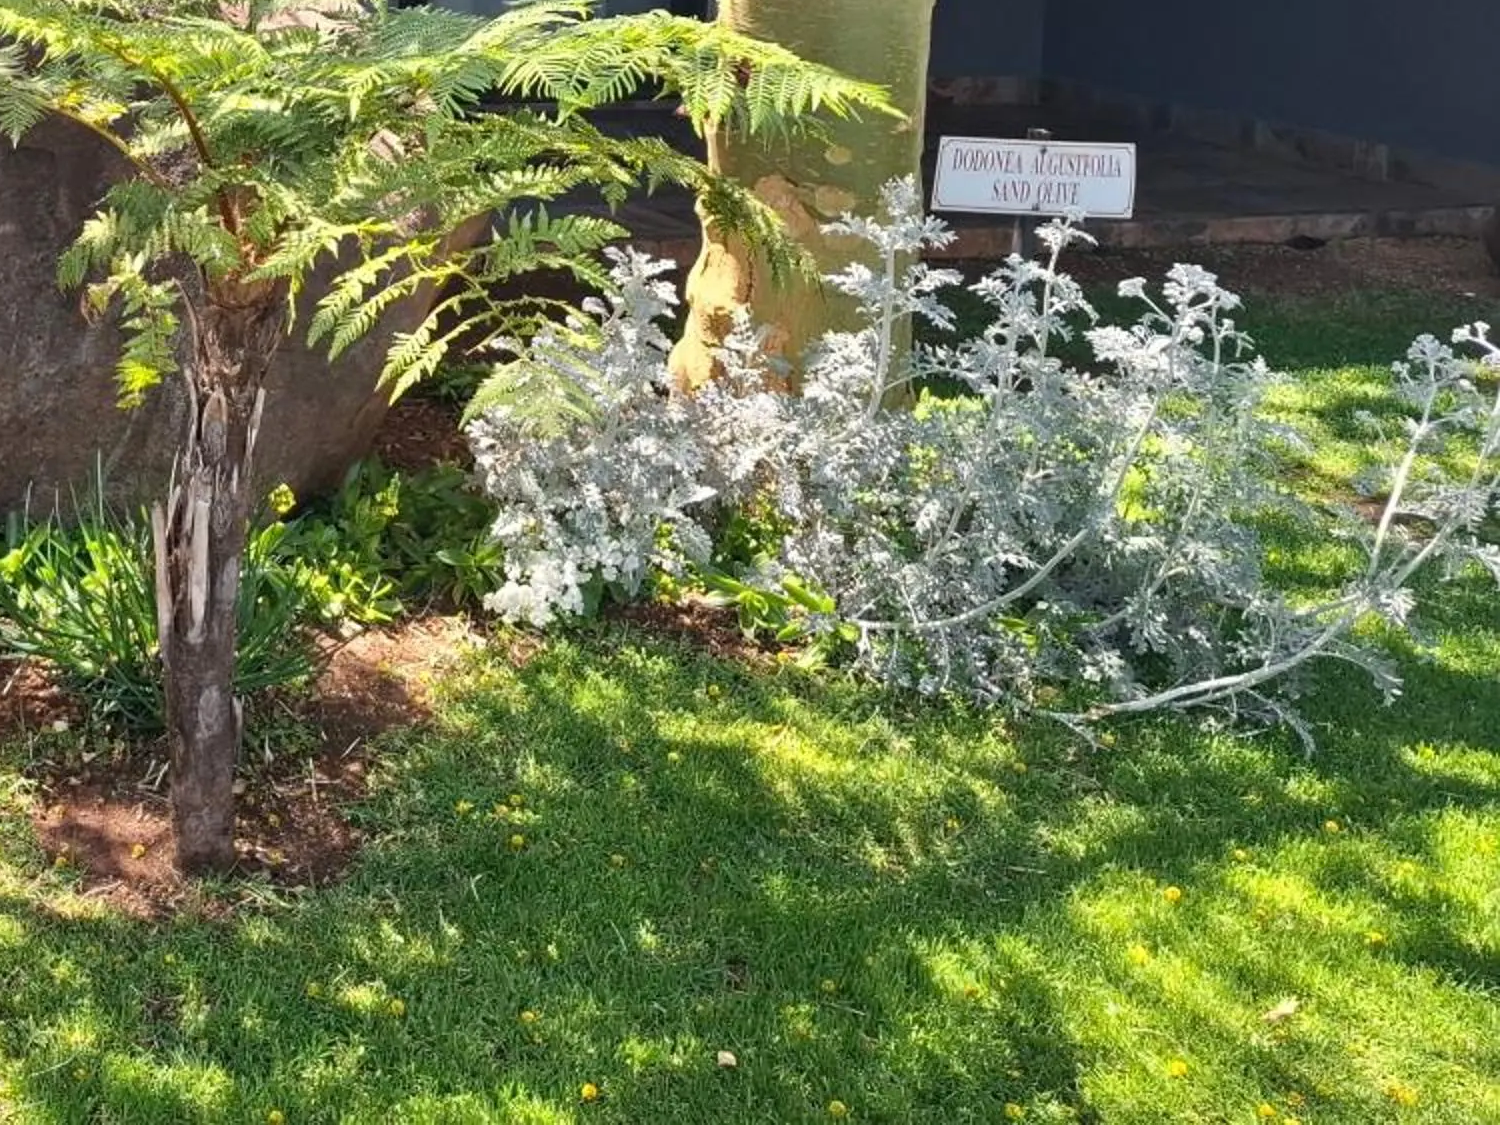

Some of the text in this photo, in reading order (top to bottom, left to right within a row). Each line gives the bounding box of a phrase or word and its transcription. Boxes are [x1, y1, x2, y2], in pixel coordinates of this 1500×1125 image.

[951, 147, 1023, 175] DODONEA
[991, 179, 1081, 205] SAND OLIVE
